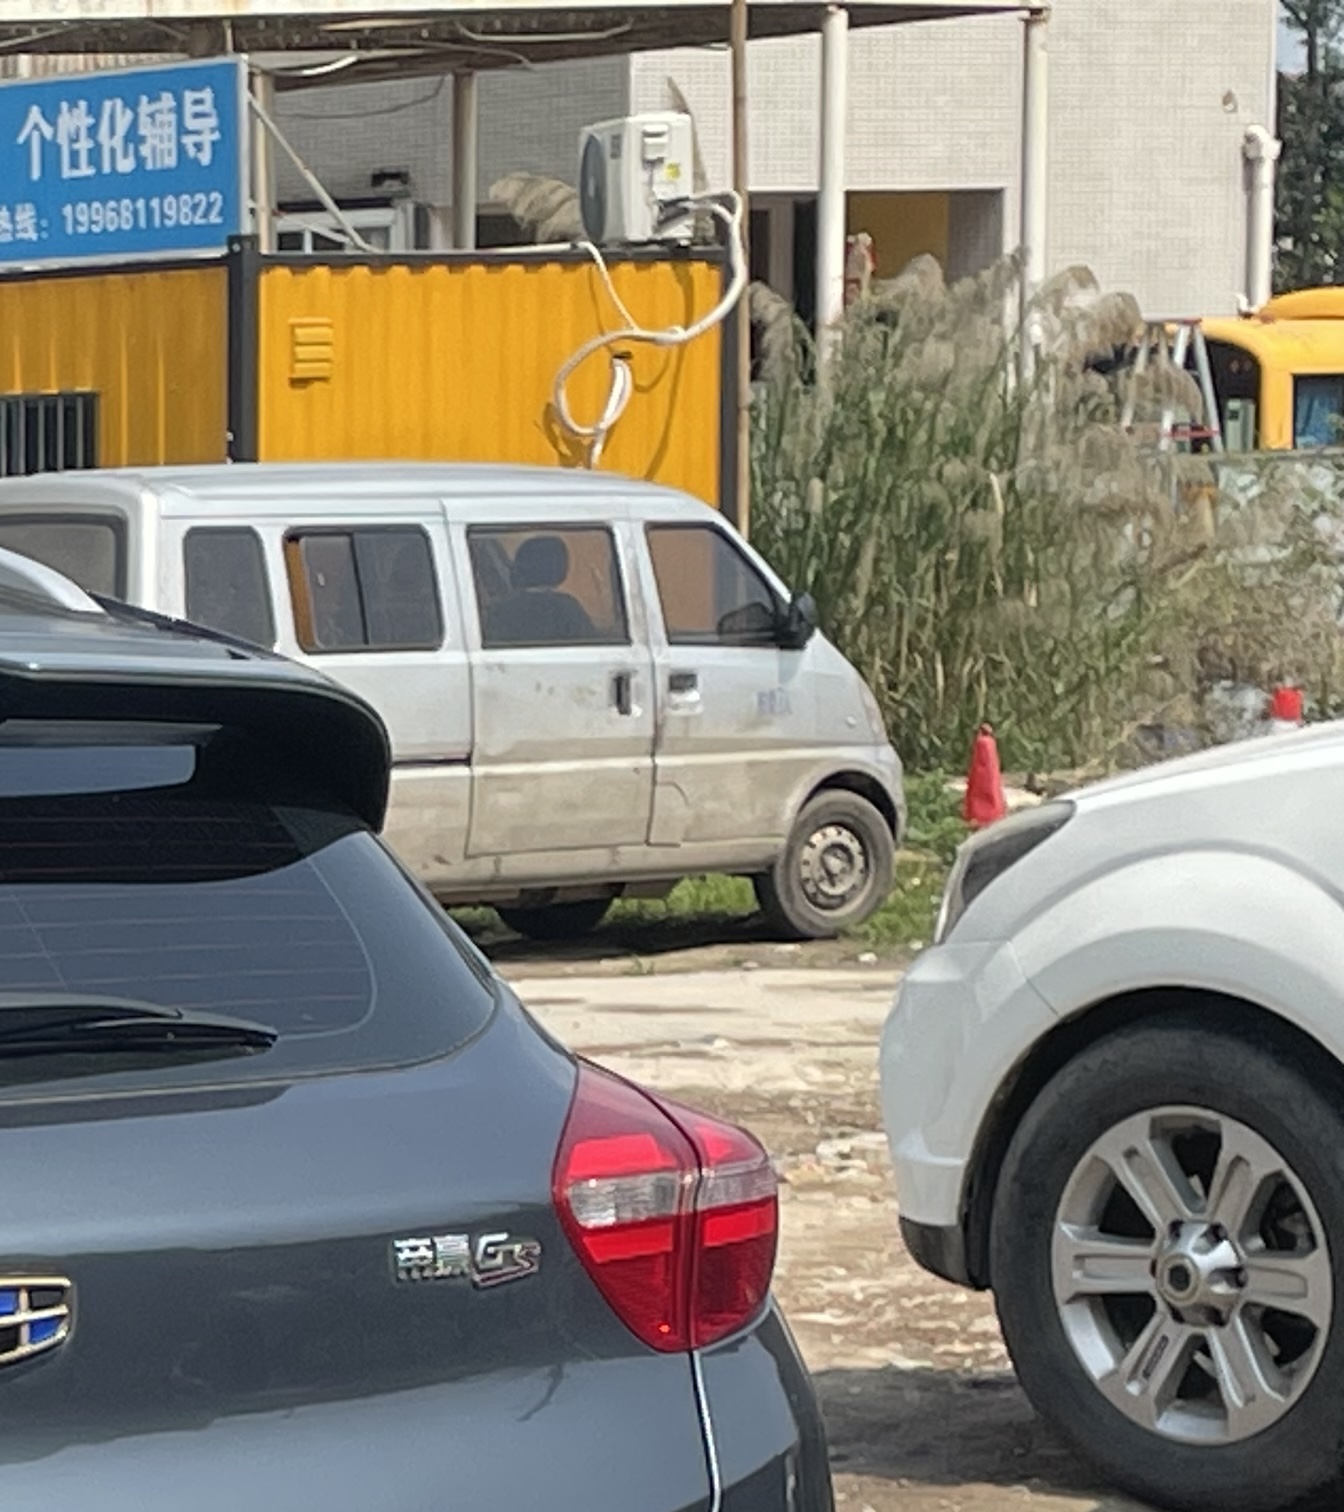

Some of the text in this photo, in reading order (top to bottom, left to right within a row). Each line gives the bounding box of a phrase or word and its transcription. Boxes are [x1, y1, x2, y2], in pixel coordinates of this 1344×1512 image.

[17, 87, 221, 181] 个性化辅导
